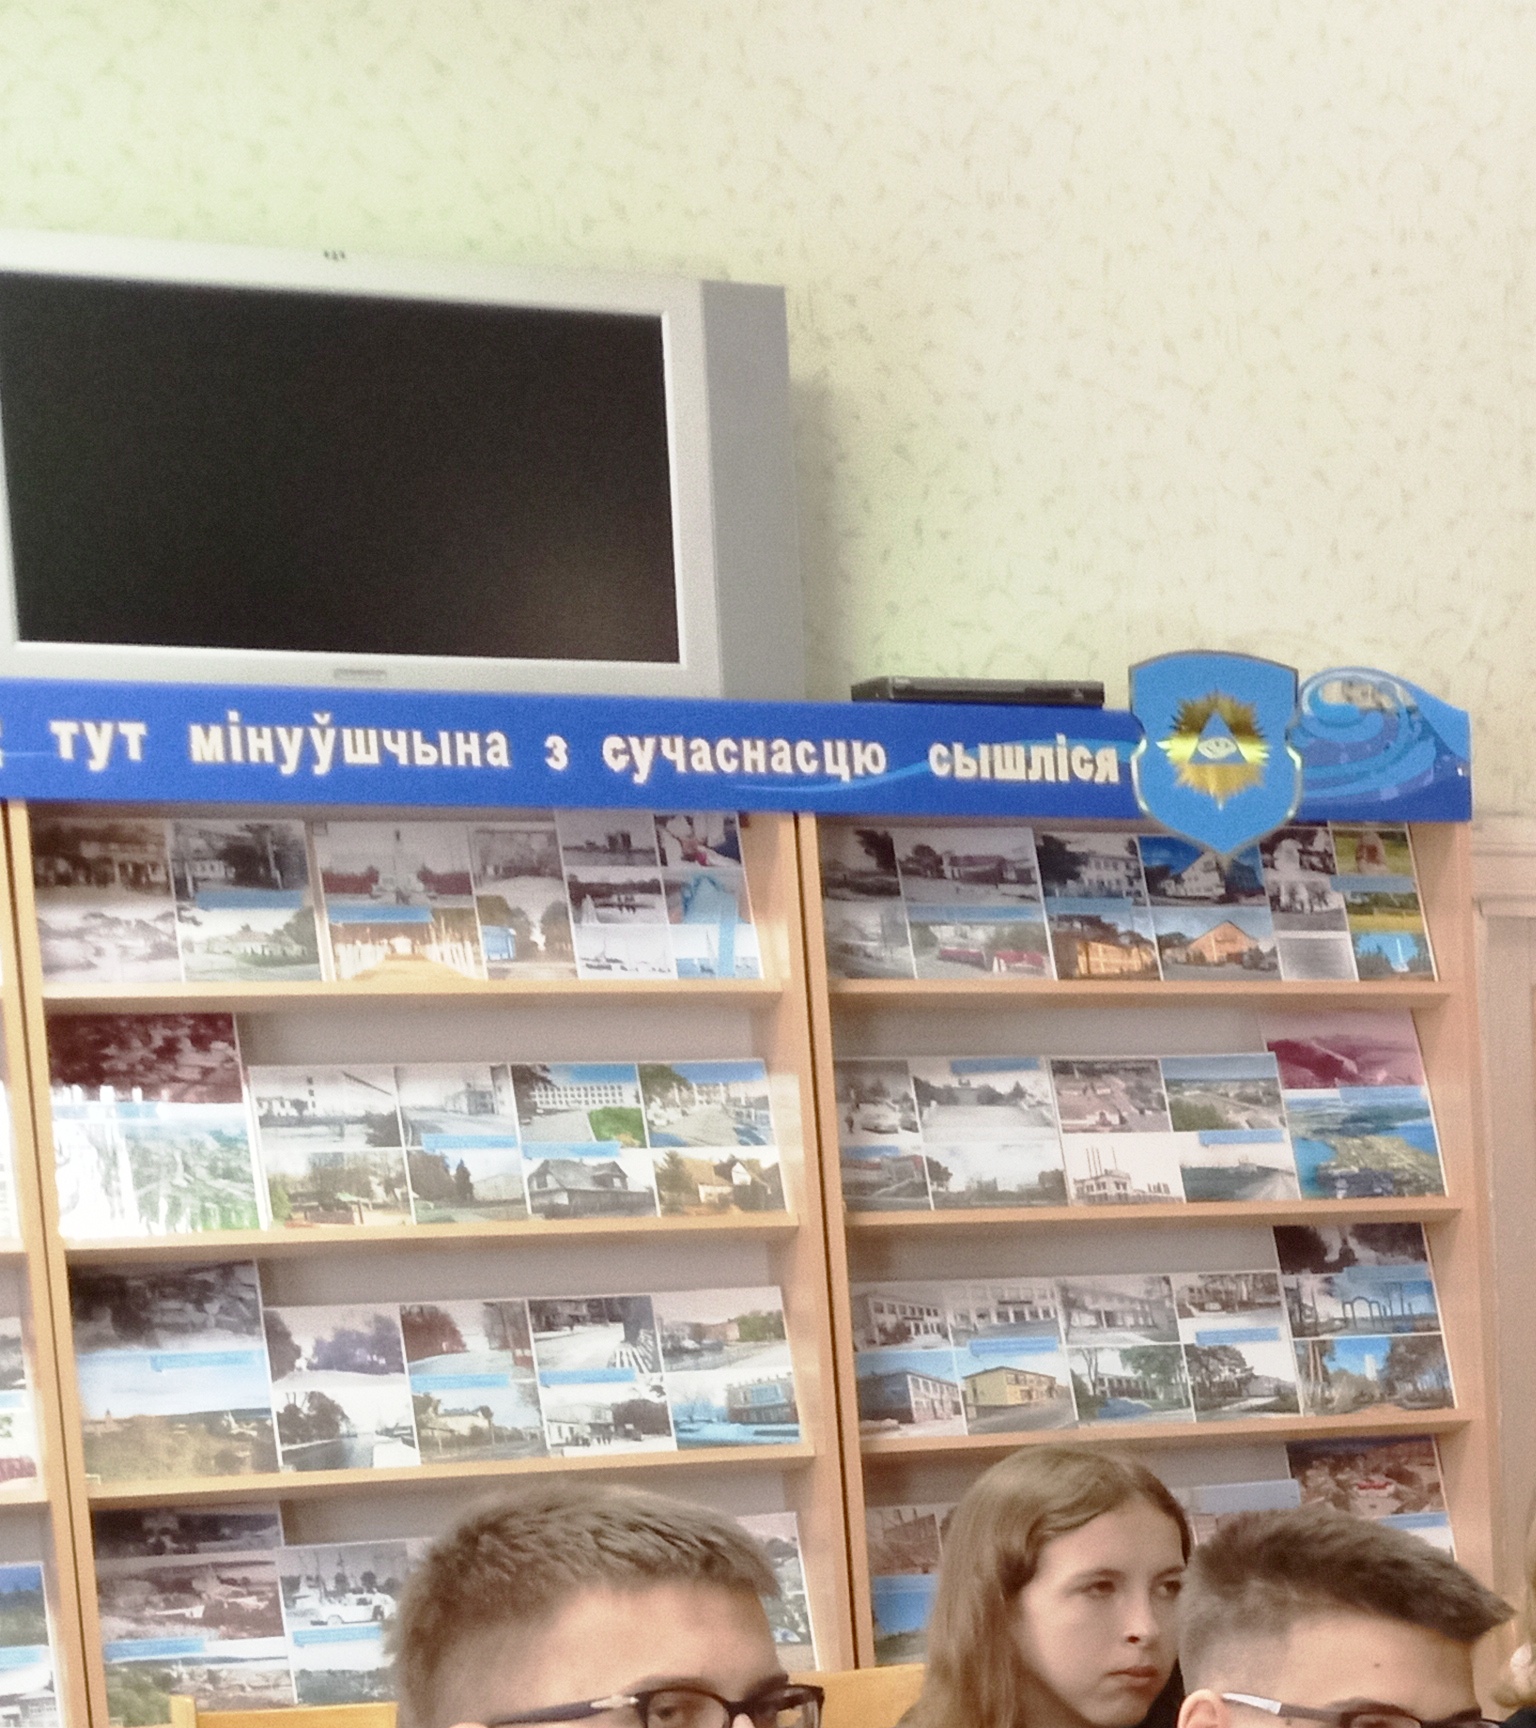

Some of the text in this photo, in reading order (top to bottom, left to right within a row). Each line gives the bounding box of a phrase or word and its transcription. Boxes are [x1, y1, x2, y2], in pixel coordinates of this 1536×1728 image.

[49, 708, 1120, 784] тут мінуўшчына з сучаснасцю сышліся
